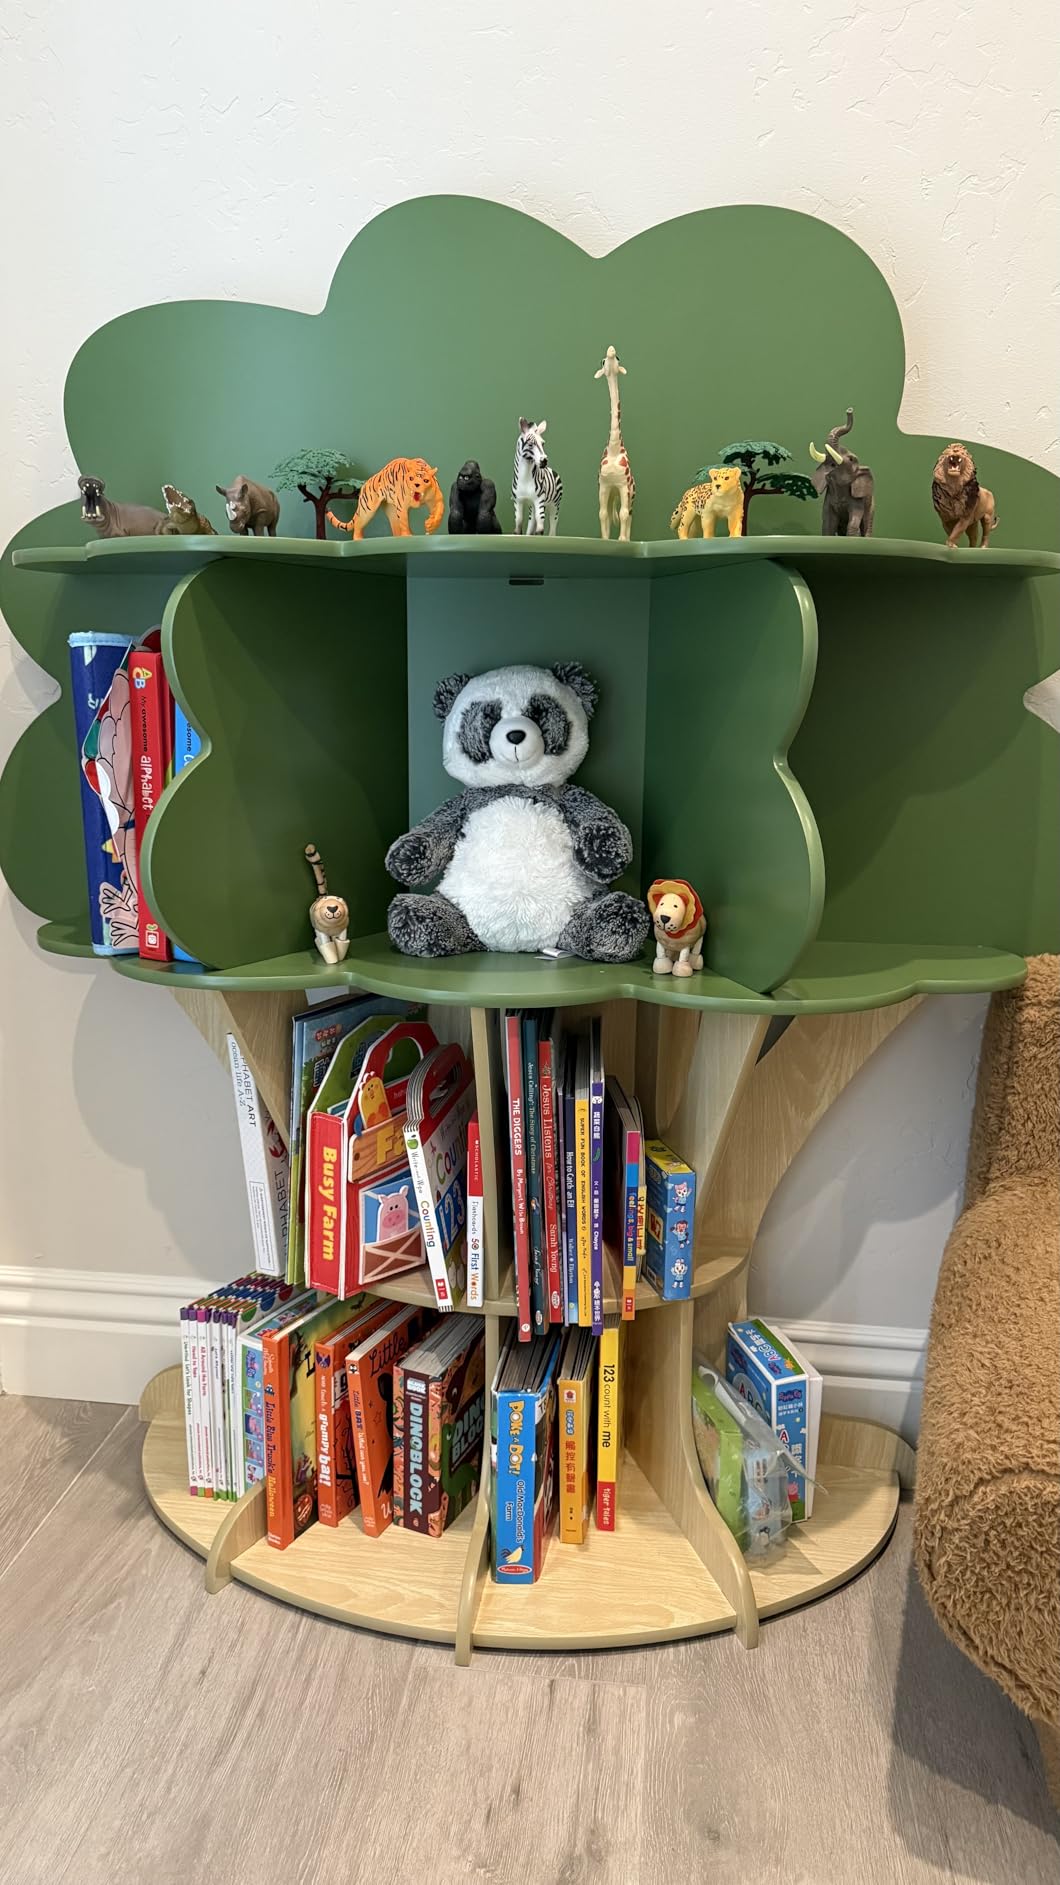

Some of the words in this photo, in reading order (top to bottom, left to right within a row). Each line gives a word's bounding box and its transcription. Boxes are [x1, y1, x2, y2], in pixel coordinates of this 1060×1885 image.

[139, 696, 147, 708] My
[139, 755, 154, 811] alphabet
[231, 1041, 241, 1069] ocean
[236, 1071, 244, 1087] life
[238, 1089, 246, 1107] A-Z
[512, 1098, 521, 1116] THE
[541, 1084, 551, 1115] Jesus
[248, 1104, 257, 1127] ART
[512, 1117, 522, 1156] DIGGERS
[528, 1120, 536, 1136] Story
[543, 1118, 553, 1159] Listens
[530, 1144, 538, 1174] Christmas
[545, 1162, 553, 1175] for
[566, 1151, 574, 1165] How
[318, 1146, 338, 1202] Busy
[516, 1168, 524, 1177] By
[566, 1173, 574, 1190] Catch
[580, 1169, 586, 1178] OF
[546, 1176, 555, 1210] Christmas
[567, 1199, 575, 1208] Elf
[471, 1201, 479, 1235] Flashcards
[627, 1192, 637, 1225] feelings,
[322, 1204, 338, 1261] Farm
[420, 1200, 437, 1248] Counting
[626, 1225, 635, 1237] big
[471, 1238, 479, 1251] 50
[550, 1223, 558, 1248] Sarah
[471, 1253, 479, 1270] First
[549, 1249, 558, 1273] Young
[627, 1243, 635, 1261] small
[470, 1273, 479, 1301] Words
[604, 1364, 615, 1382] 123
[320, 1389, 328, 1407] touch
[603, 1383, 612, 1408] count
[266, 1401, 276, 1423] Little
[355, 1410, 363, 1430] BAT
[509, 1400, 525, 1435] POKE
[603, 1409, 612, 1428] with
[266, 1424, 276, 1441] Blue
[319, 1413, 330, 1454] grumpy
[602, 1430, 611, 1448] me
[267, 1443, 276, 1474] Truck's
[409, 1401, 423, 1515] DINOBLOCK
[508, 1443, 524, 1477] DOT!
[319, 1454, 331, 1487] bat!
[268, 1476, 277, 1517] Halloween
[517, 1479, 525, 1494] Old
[603, 1488, 611, 1506] tiger
[504, 1501, 513, 1521] Farm
[515, 1495, 525, 1543] MacDonald's
[603, 1507, 611, 1525] tales
